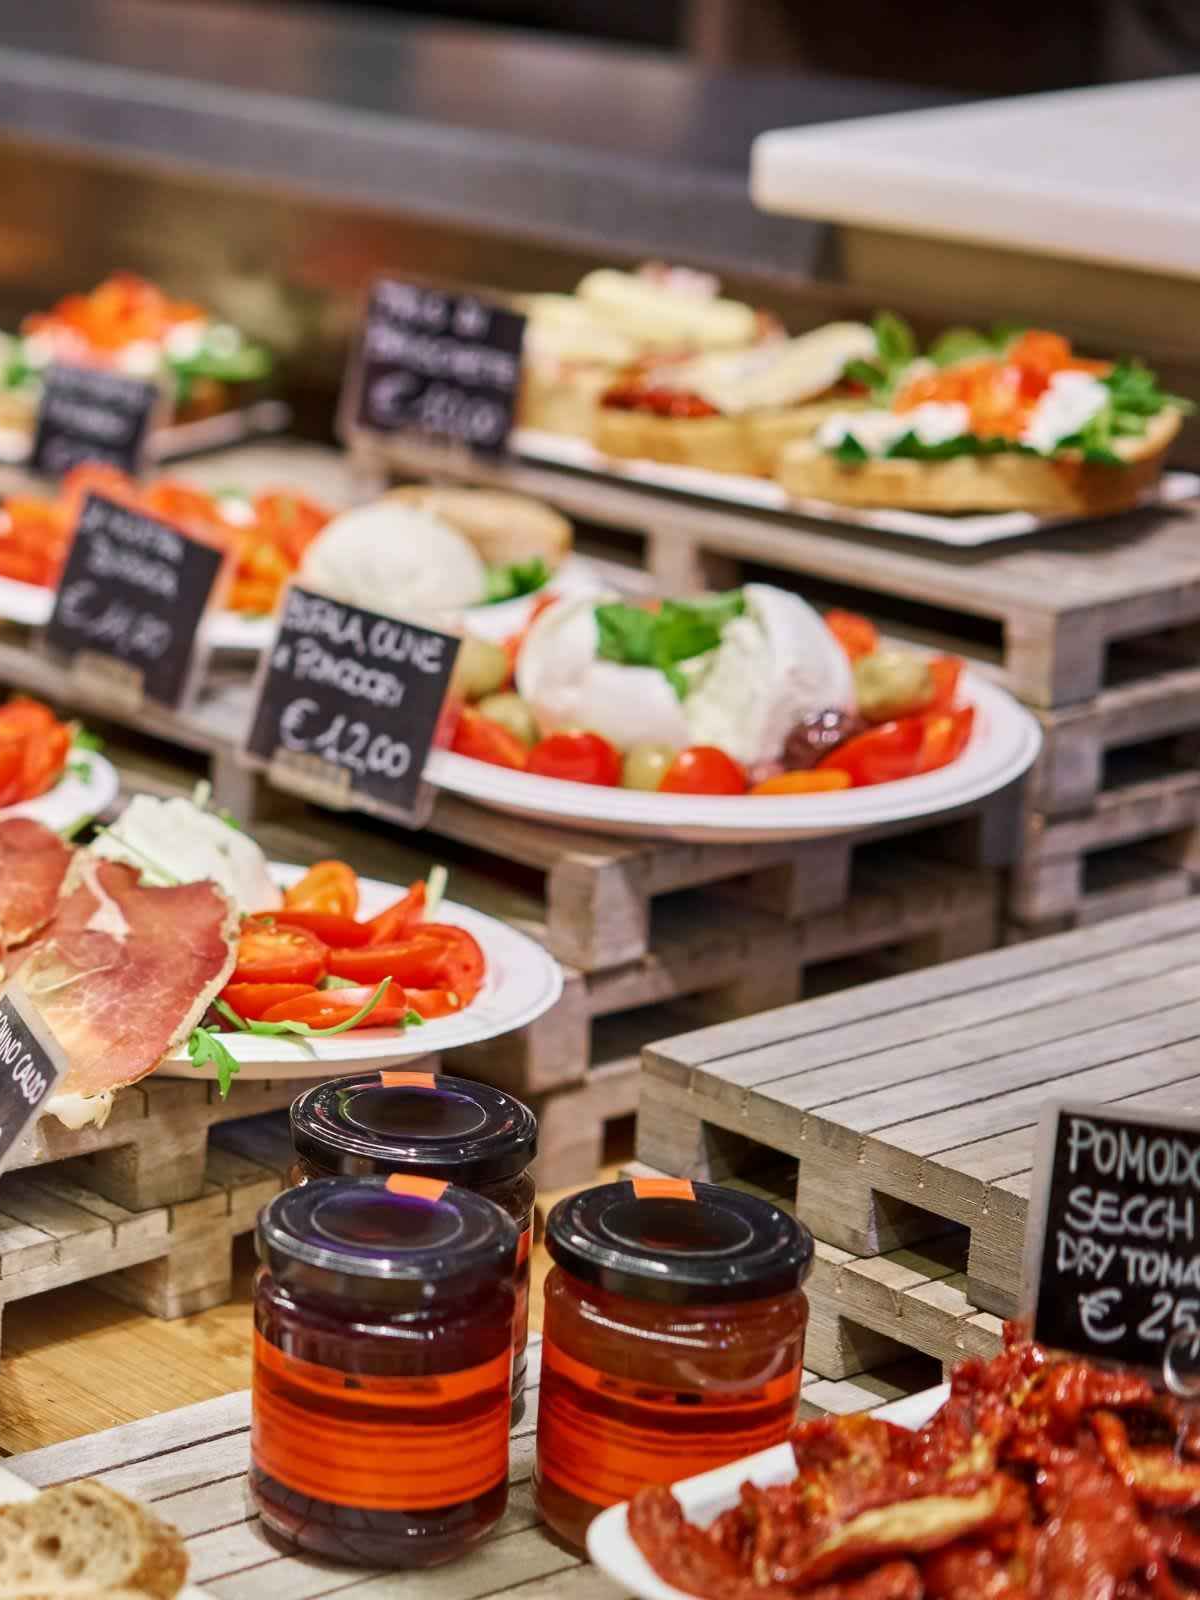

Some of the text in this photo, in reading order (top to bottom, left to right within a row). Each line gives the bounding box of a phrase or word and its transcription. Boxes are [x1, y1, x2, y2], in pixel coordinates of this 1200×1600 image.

[280, 698, 320, 750] €
[12, 1053, 47, 1105] CALDO
[1057, 1230, 1116, 1281] DRY
[1078, 1287, 1126, 1342] €
